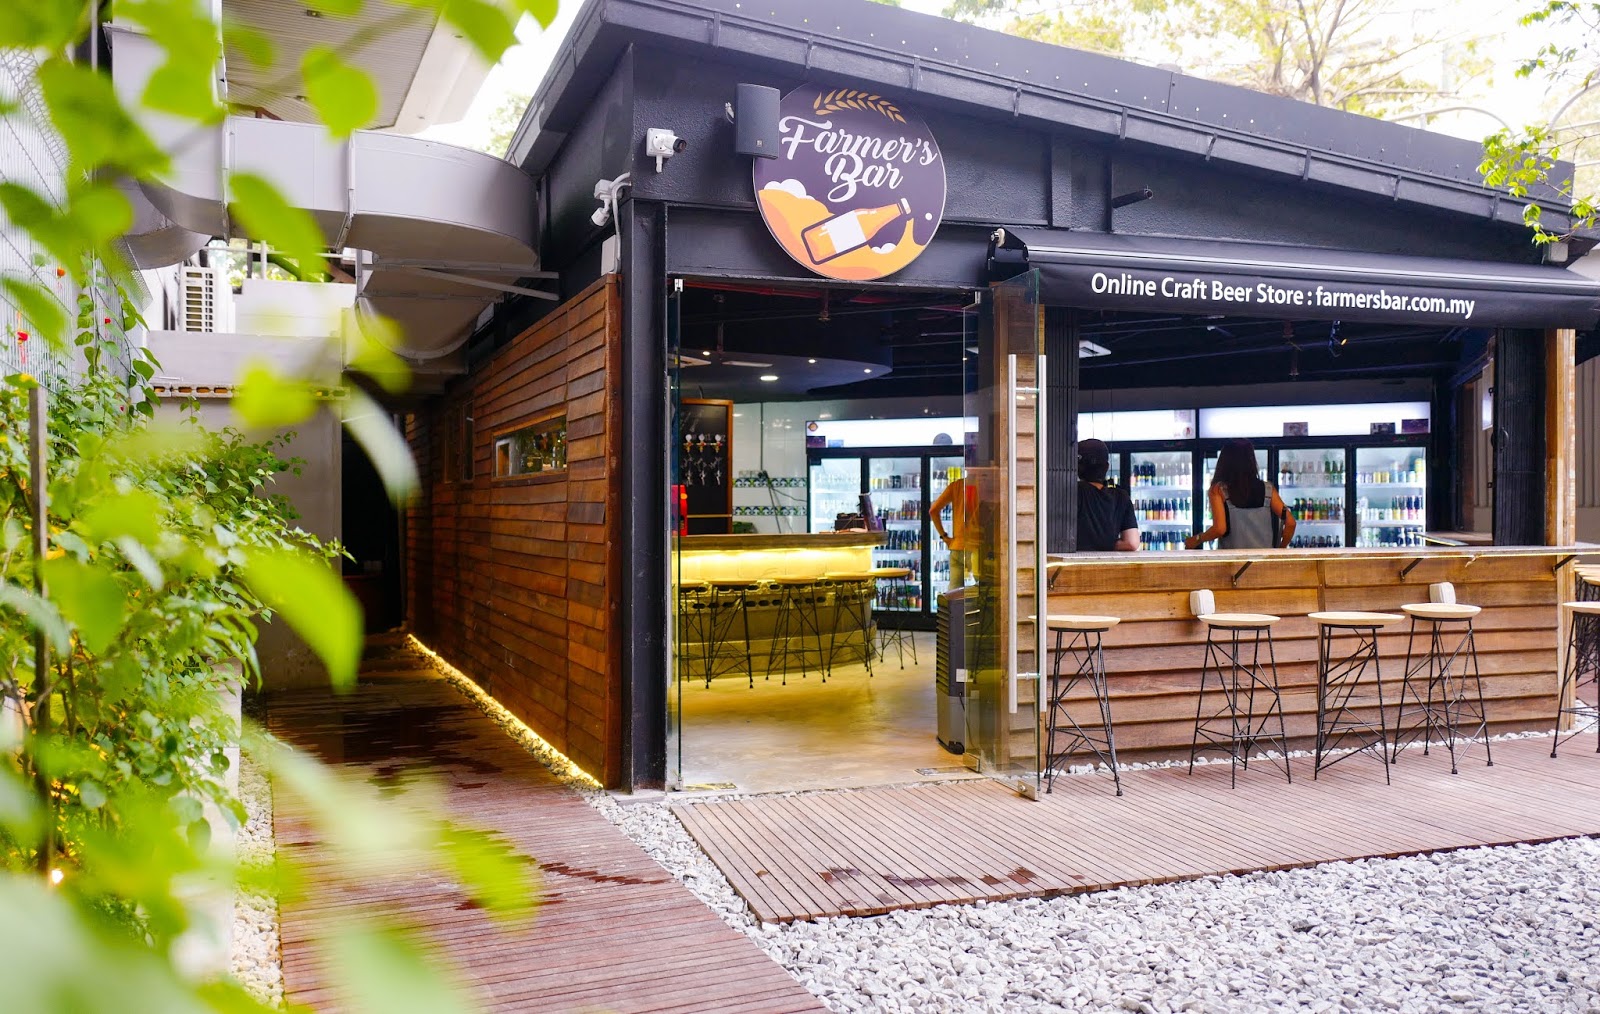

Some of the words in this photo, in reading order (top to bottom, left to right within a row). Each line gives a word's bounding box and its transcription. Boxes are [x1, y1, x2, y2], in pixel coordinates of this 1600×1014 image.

[778, 115, 938, 166] Farmer's
[824, 152, 904, 203] Bar
[1091, 272, 1157, 296] Online
[1161, 276, 1208, 300] Craft
[1211, 280, 1253, 303] Beer
[1256, 283, 1304, 306] Store
[1315, 285, 1475, 320] farmersbar.com.my
